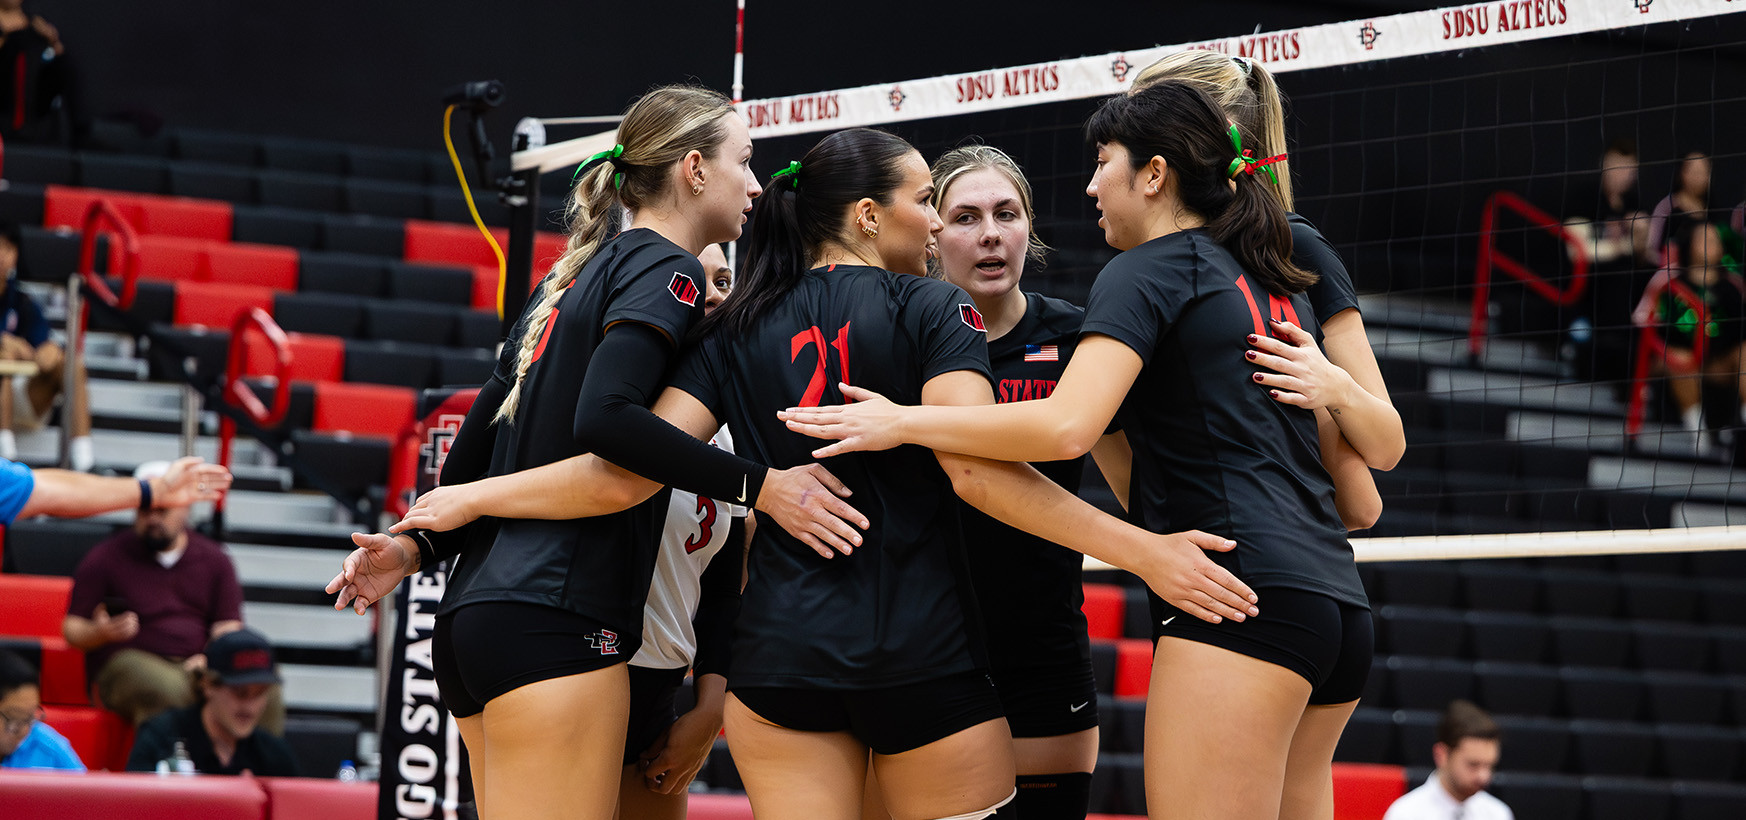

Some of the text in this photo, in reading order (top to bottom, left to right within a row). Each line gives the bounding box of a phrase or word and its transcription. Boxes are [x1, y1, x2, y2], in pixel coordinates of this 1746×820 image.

[1442, 0, 1567, 39] SDSU AZTECS
[1239, 32, 1299, 63] AZTECS
[956, 65, 1059, 103] SDSU AZTECS
[747, 94, 840, 128] SDSU AZTECS
[791, 320, 851, 408] 21
[685, 494, 717, 554] 3
[401, 569, 447, 736] STATE
